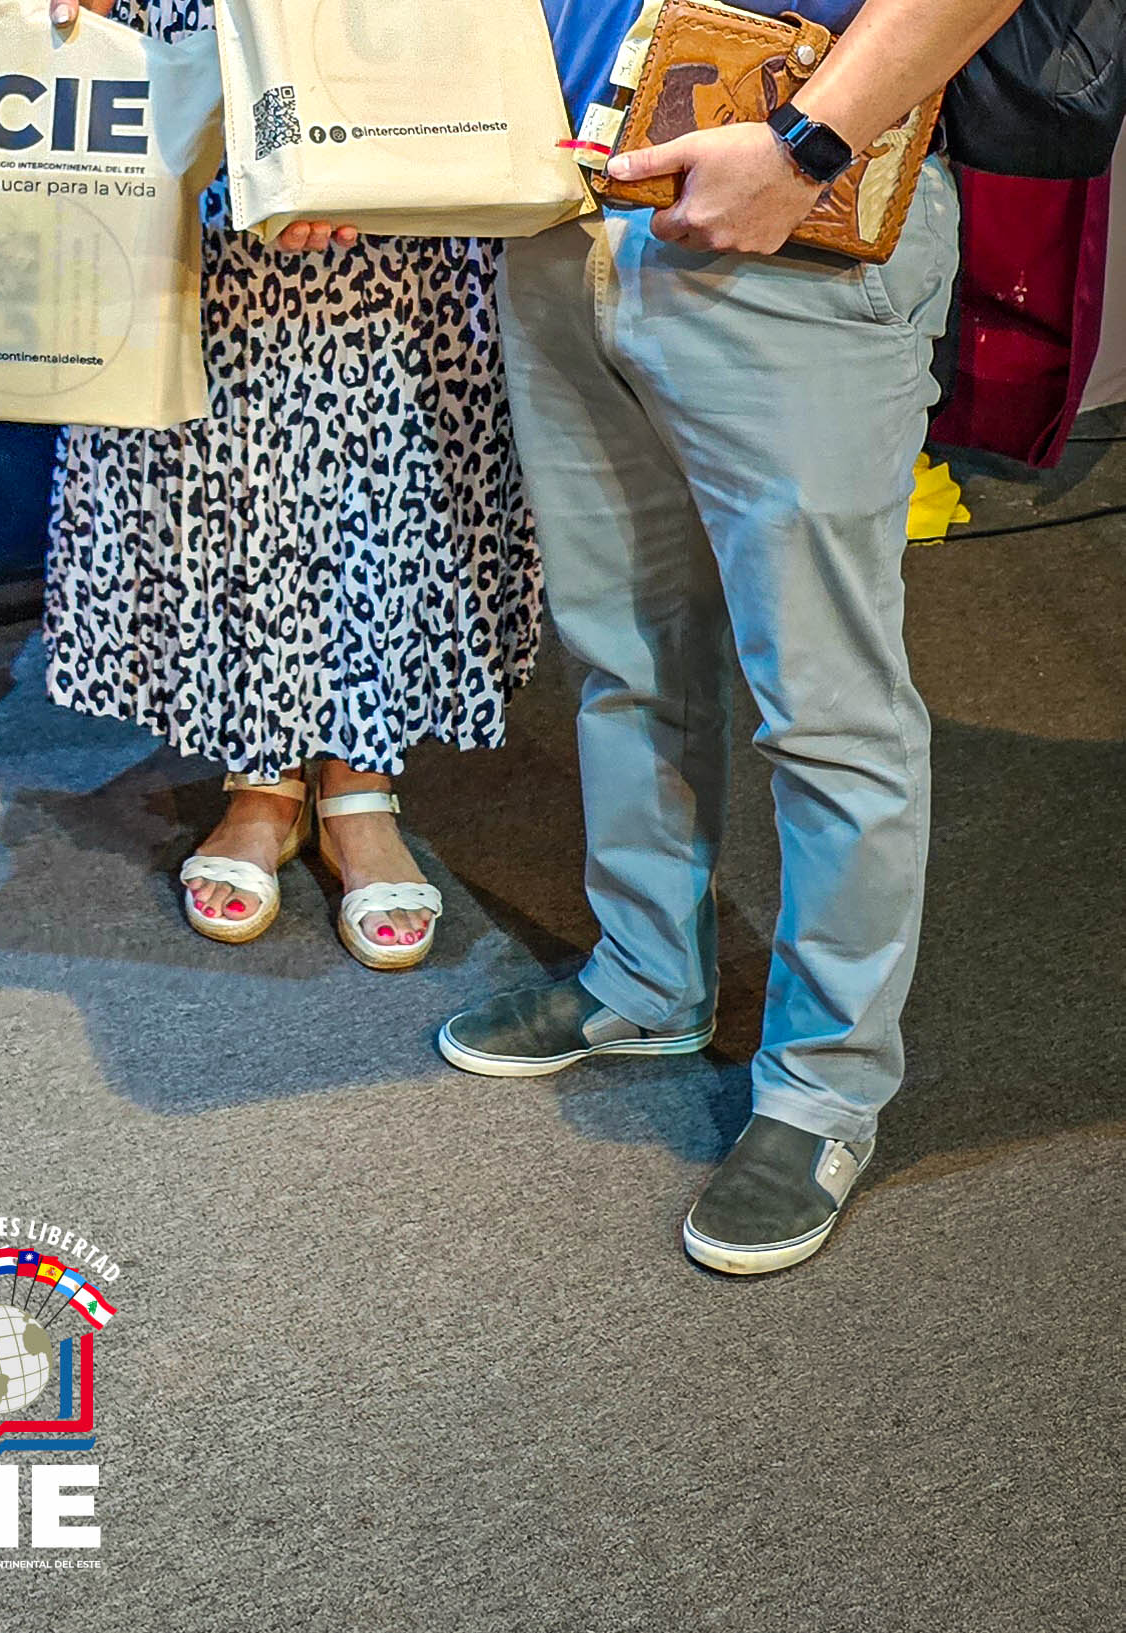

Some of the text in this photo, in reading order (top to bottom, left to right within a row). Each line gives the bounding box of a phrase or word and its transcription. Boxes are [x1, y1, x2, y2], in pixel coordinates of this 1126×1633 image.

[18, 161, 103, 173] INTERCONTINENTAL
[105, 165, 122, 173] DEL
[124, 166, 146, 174] ESTE
[47, 180, 88, 197] para
[94, 180, 110, 196] la
[114, 181, 157, 198] Vida
